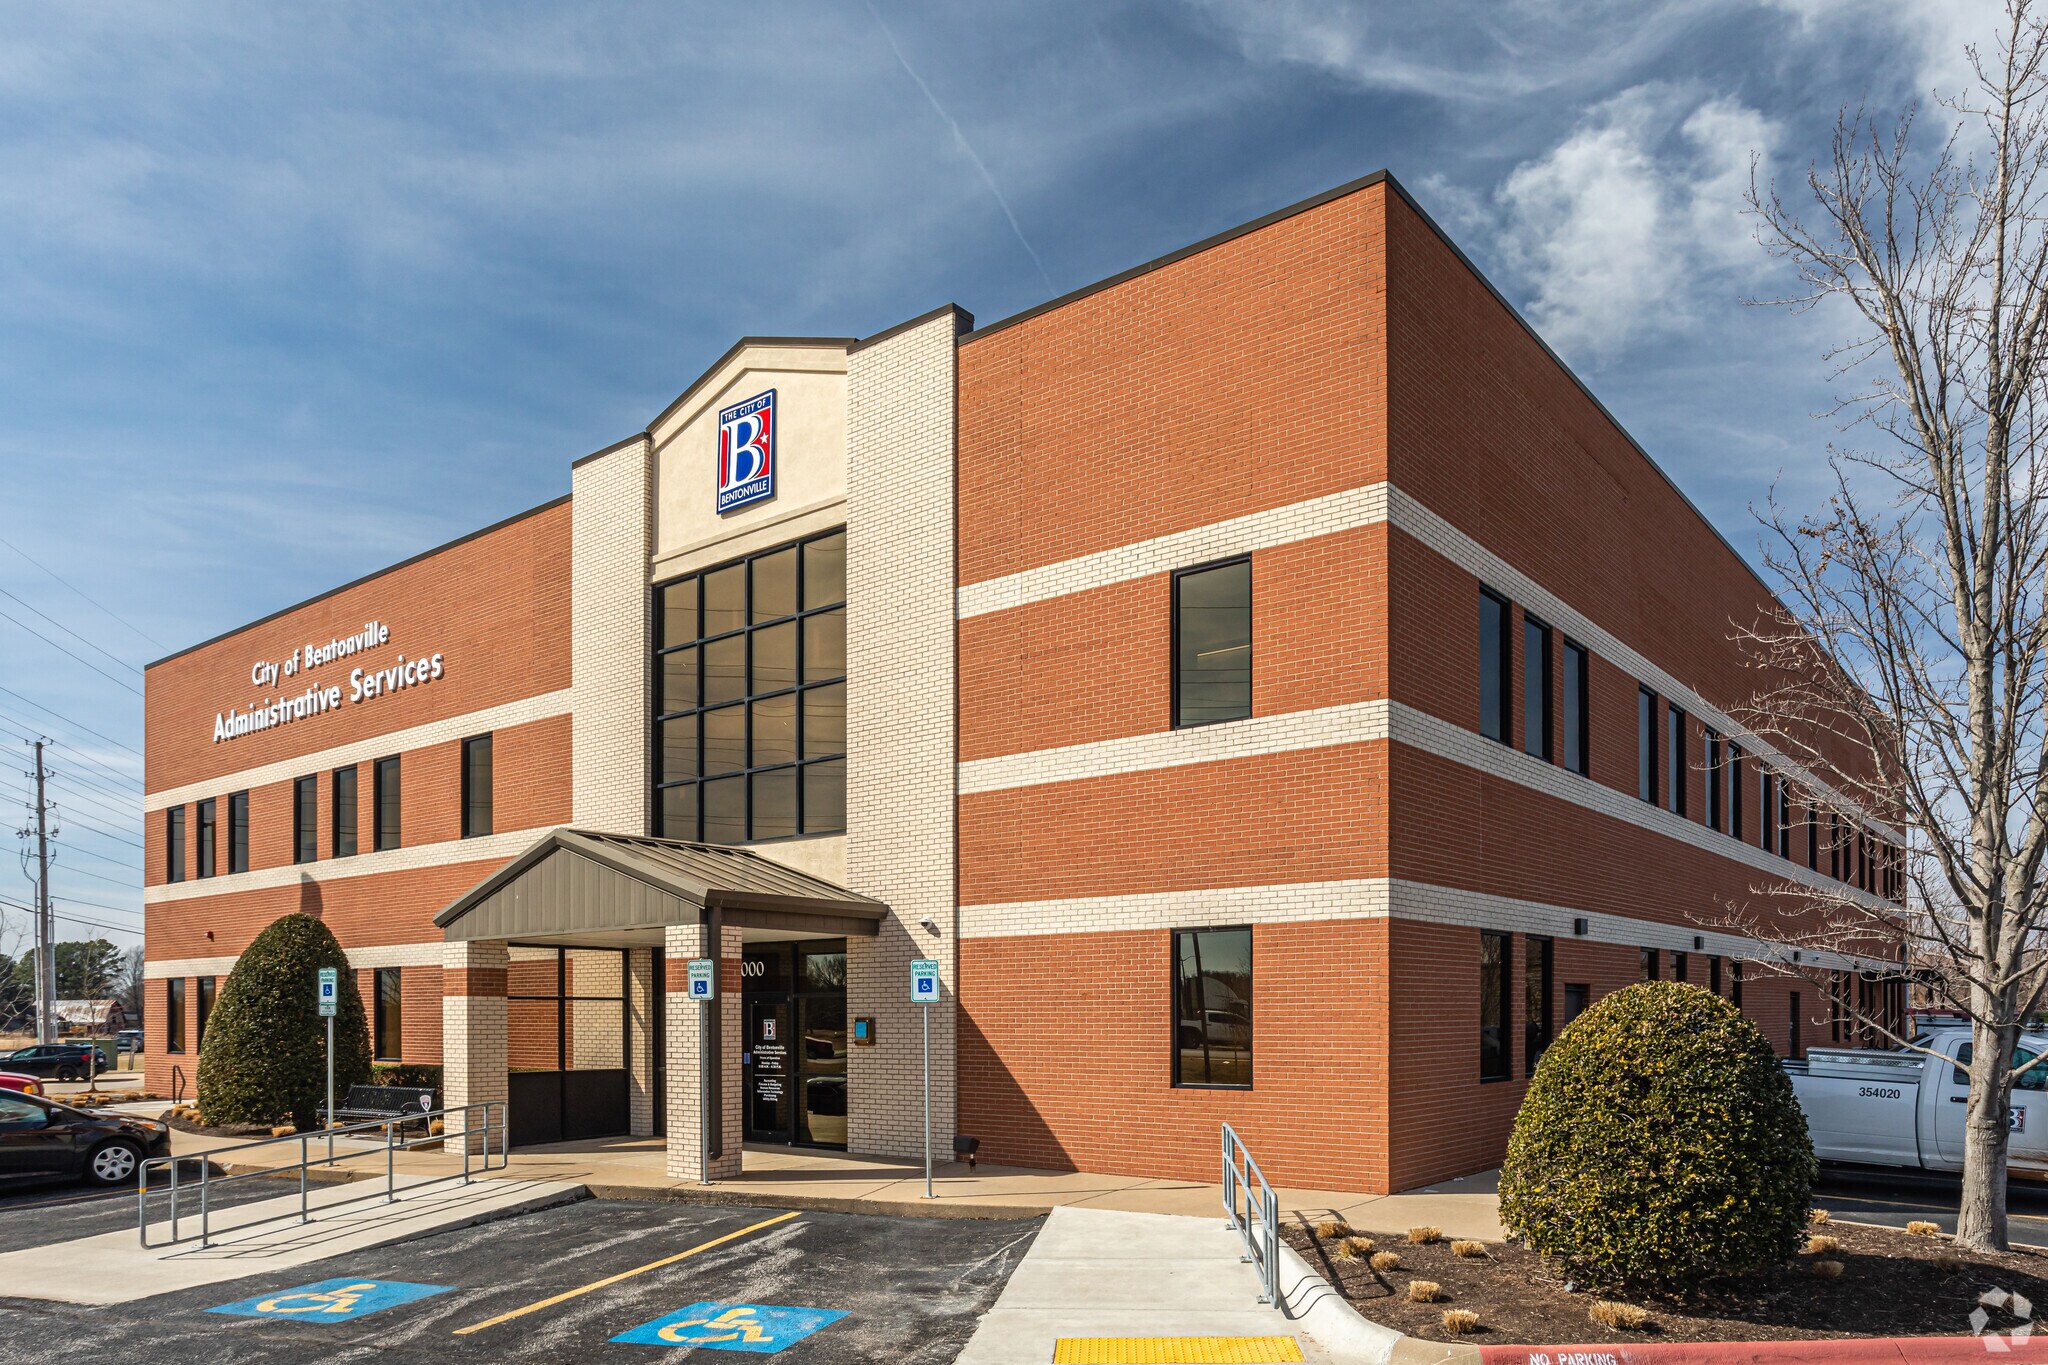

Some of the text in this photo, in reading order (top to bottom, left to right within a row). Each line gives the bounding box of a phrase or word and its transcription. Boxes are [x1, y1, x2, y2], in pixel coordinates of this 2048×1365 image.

[725, 399, 766, 421] THE CITY OF
[721, 413, 765, 489] B
[721, 480, 767, 505] BENTONVILLE
[252, 621, 390, 687] City of Bentonville
[213, 653, 444, 743] Administrative Services
[1859, 1086, 1900, 1099] 354020
[1529, 1353, 1616, 1365] NO PARKING
